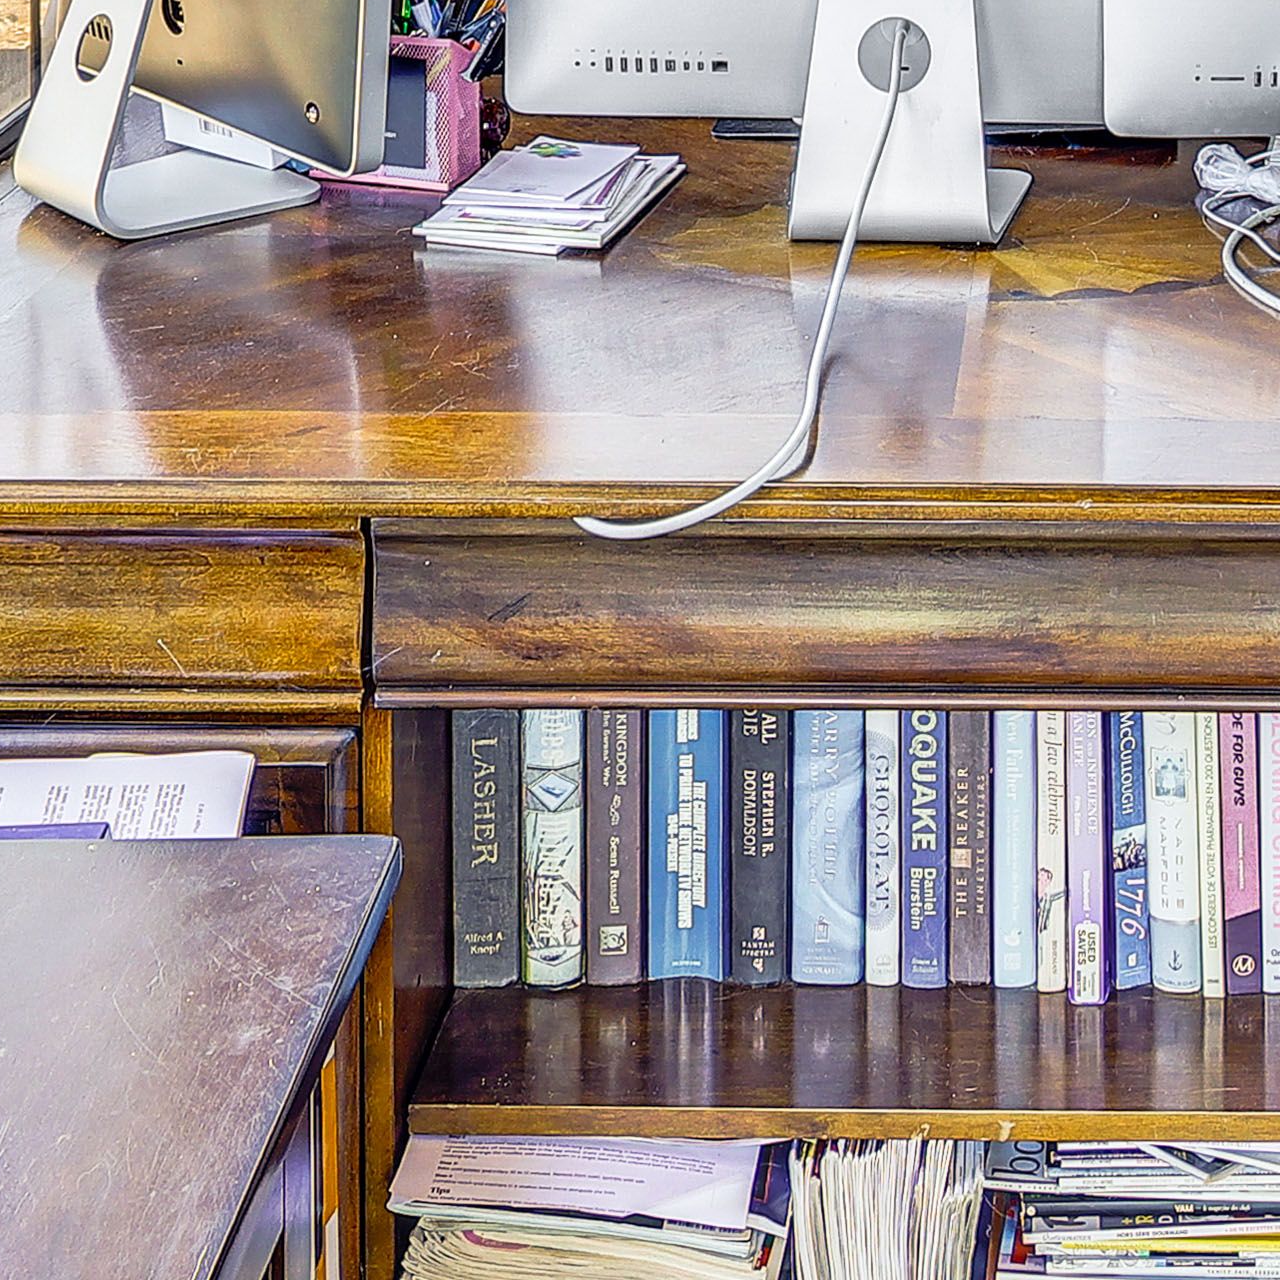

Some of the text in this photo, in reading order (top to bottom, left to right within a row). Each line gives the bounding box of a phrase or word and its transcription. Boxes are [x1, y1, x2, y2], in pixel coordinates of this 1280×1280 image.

[614, 712, 628, 787] KINGDOM
[760, 712, 778, 745] ALL
[1231, 733, 1244, 762] FOR
[679, 753, 693, 770] TO
[1005, 747, 1027, 800] Father
[1073, 737, 1085, 767] LIFE
[602, 766, 612, 788] War
[679, 770, 693, 802] PRIME
[1044, 726, 1064, 836] a Jew celebrates
[1087, 758, 1099, 834] INFLUENCE
[1231, 765, 1245, 807] GUYS
[470, 736, 499, 869] LASHER
[679, 802, 693, 827] TIME
[743, 769, 757, 856] DONALDSON
[761, 771, 776, 858] STEPHEN R.
[679, 827, 693, 876] NETWORK
[693, 780, 707, 909] THE COMPLETE DIRECTORY
[872, 754, 891, 910] CHOCOLAT
[975, 775, 987, 915] MINETTE WALTERS
[1202, 715, 1218, 949] LES CONSEILS DE VOTRE PHARMACIEN EN 200 QUESTIONS
[608, 835, 622, 915] Sean Russell
[679, 876, 693, 890] TV
[1158, 815, 1170, 910] MAHFOUZ
[678, 890, 693, 930] SHOWS
[910, 866, 924, 930] Burstein
[923, 866, 937, 916] Daniel
[956, 877, 969, 919] THE
[1115, 876, 1147, 941] 1776
[463, 931, 494, 943] Alfred
[470, 943, 501, 956] Knopf
[741, 940, 776, 949] BANTAM
[1077, 929, 1087, 966] SAVES
[1087, 931, 1097, 964] USED
[429, 1186, 451, 1196] Tips
